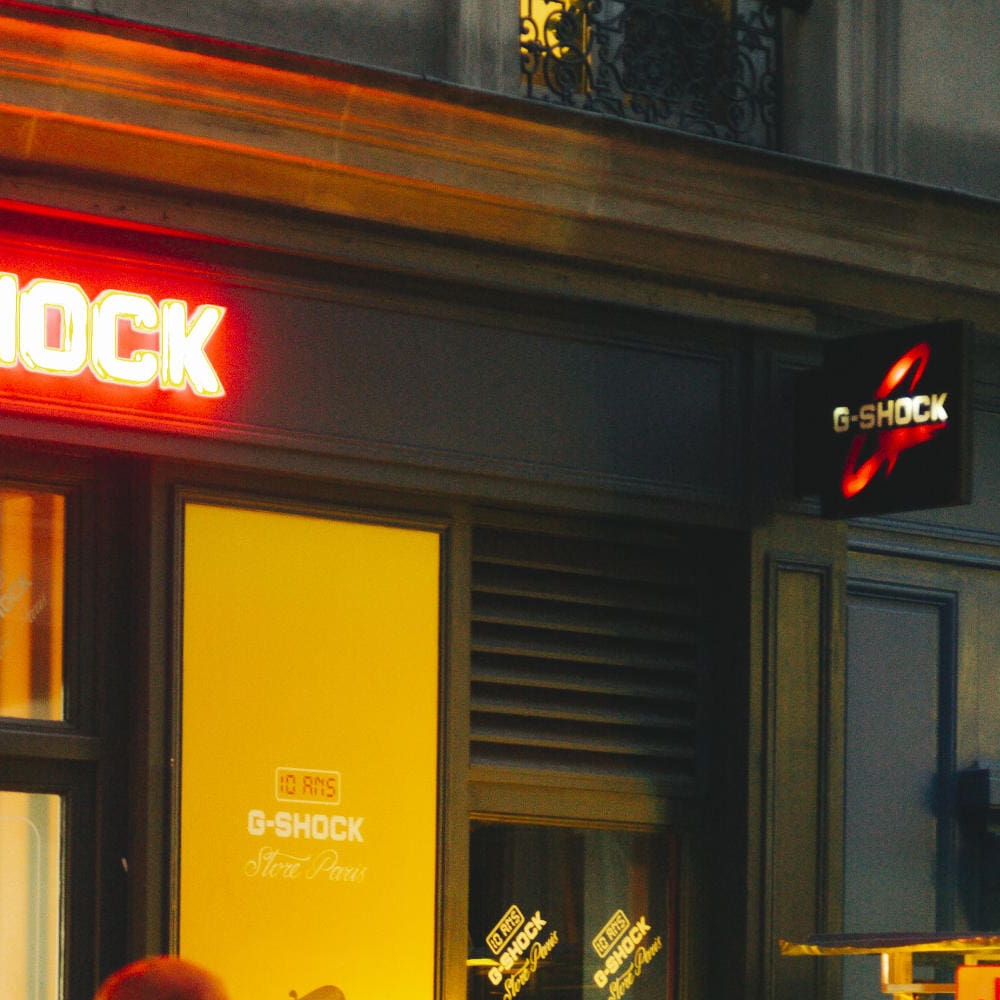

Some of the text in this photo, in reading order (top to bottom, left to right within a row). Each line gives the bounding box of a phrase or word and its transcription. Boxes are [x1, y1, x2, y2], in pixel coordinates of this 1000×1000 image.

[833, 392, 949, 433] G-SHOCK
[280, 774, 337, 799] 10 ANS
[248, 809, 365, 843] G-SHOCK
[244, 845, 368, 883] Store Paris
[488, 910, 547, 986] G-SHOCK
[593, 915, 652, 989] G-SHOCK
